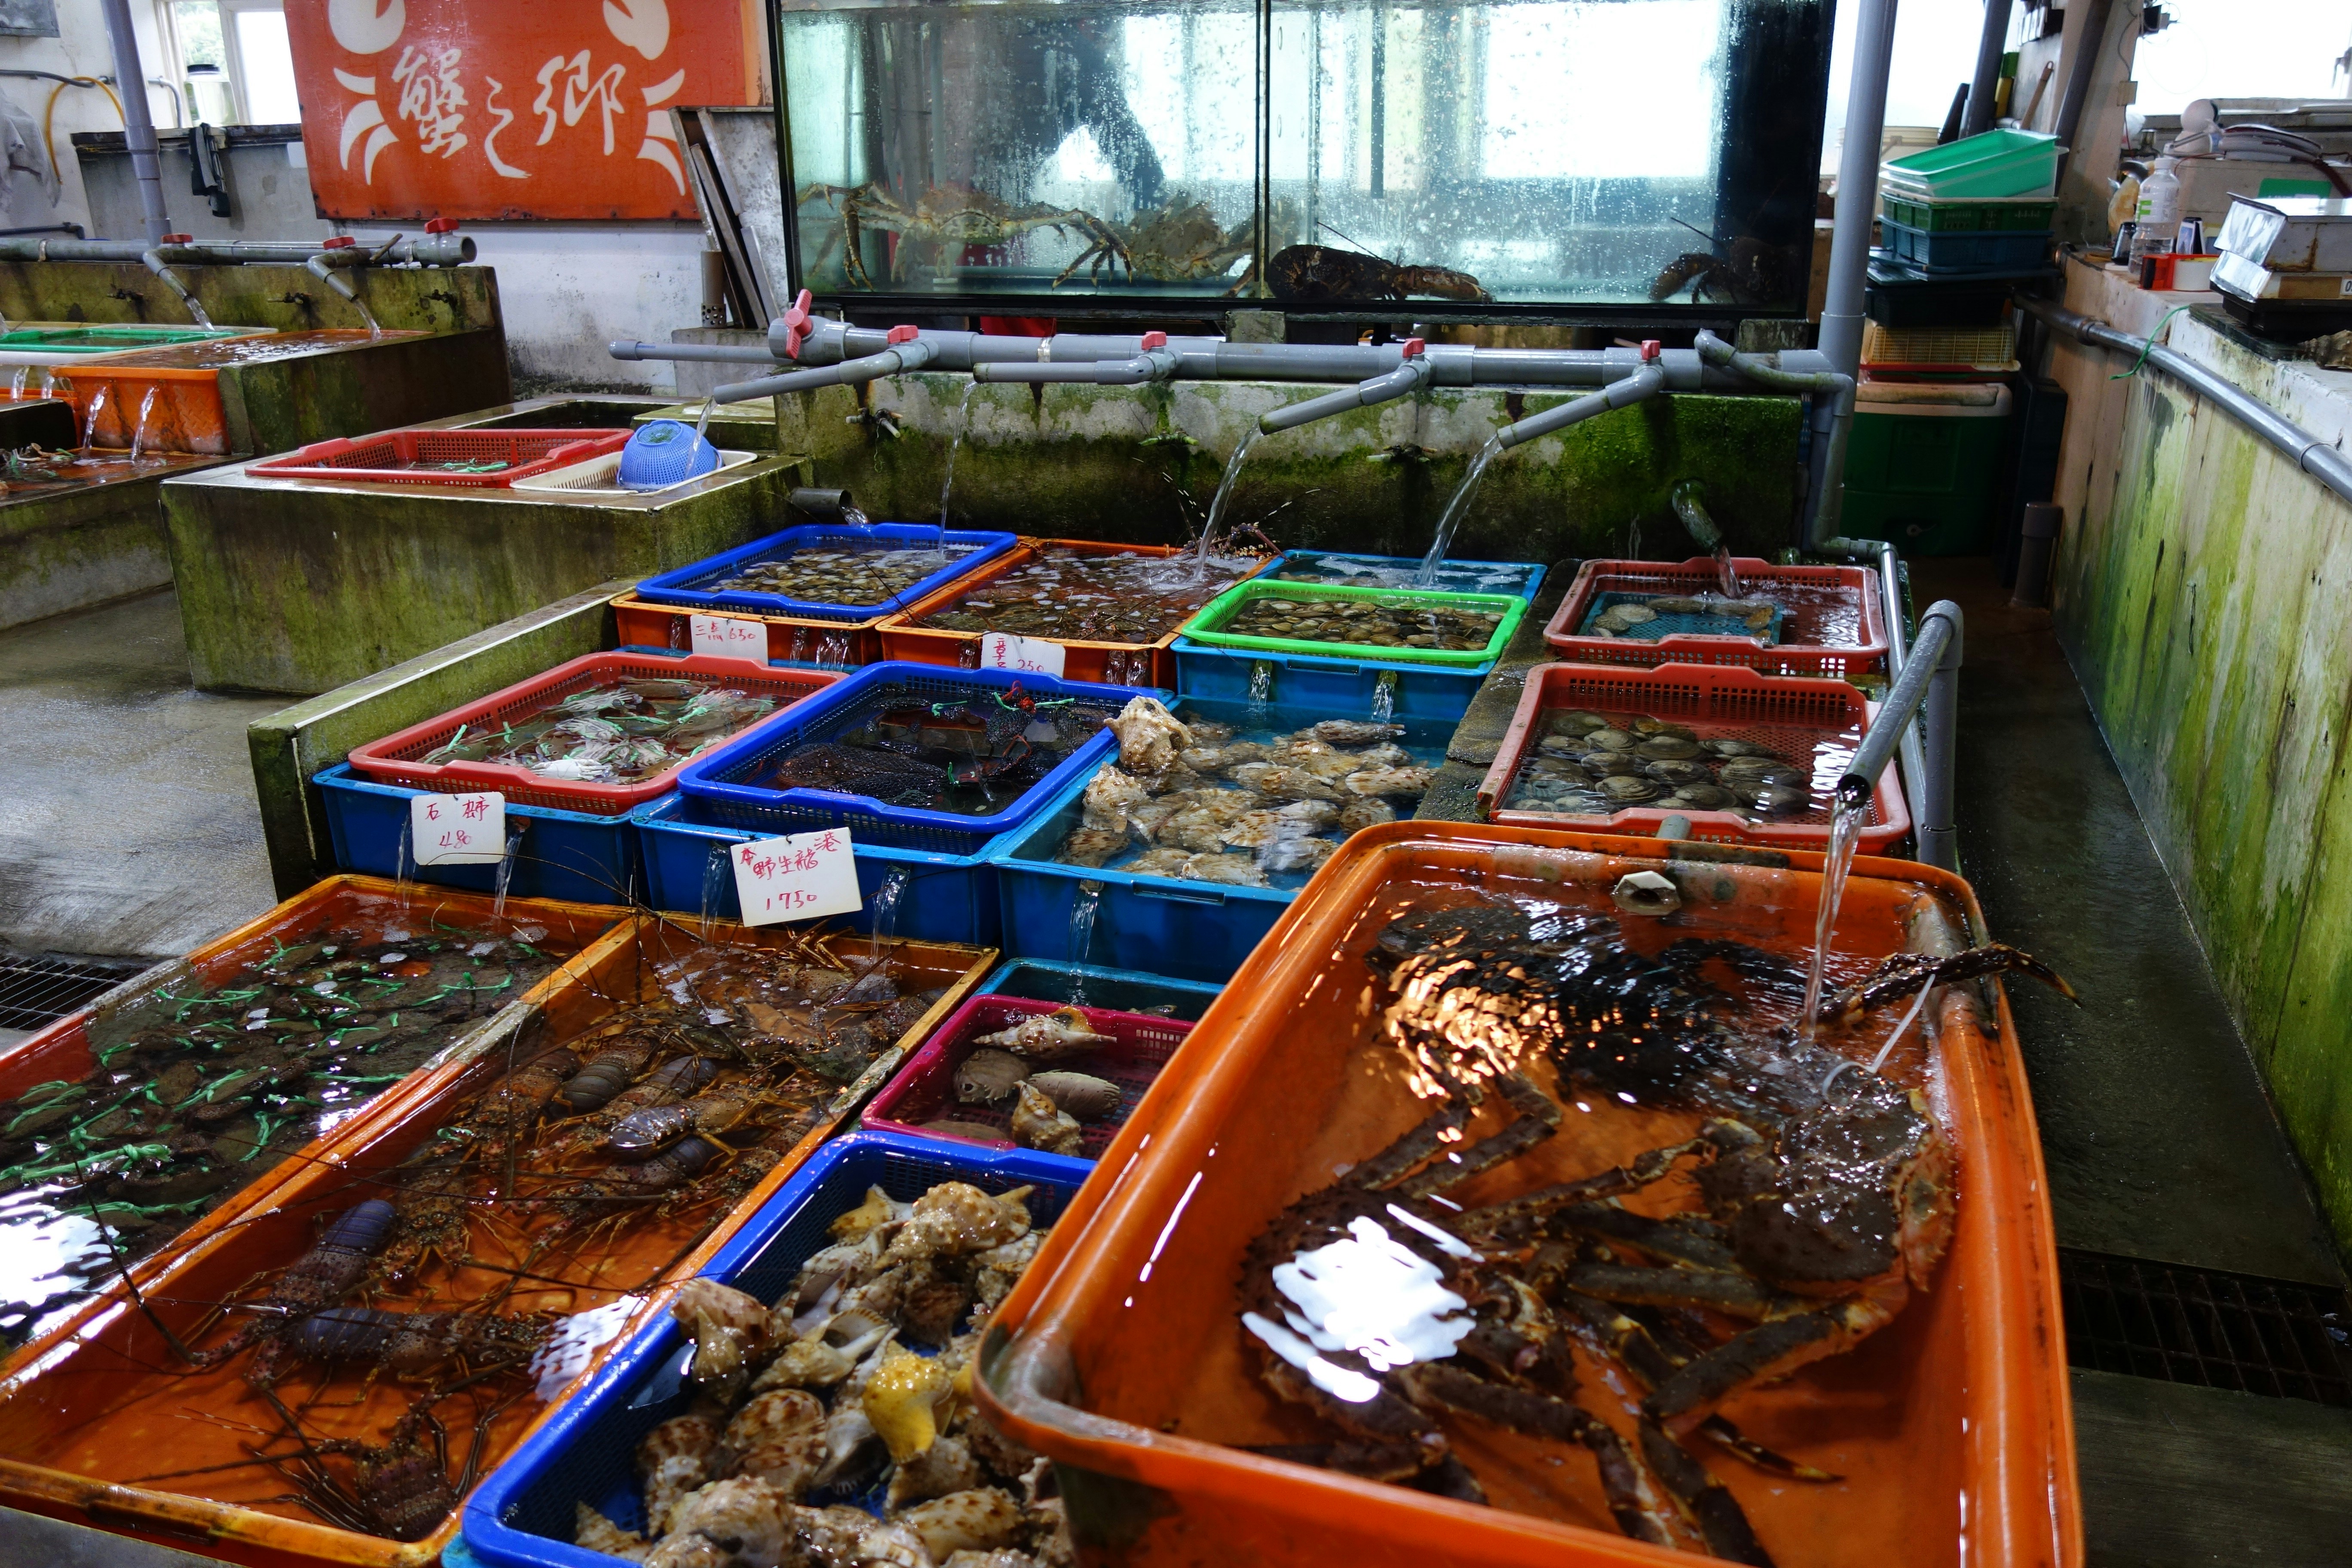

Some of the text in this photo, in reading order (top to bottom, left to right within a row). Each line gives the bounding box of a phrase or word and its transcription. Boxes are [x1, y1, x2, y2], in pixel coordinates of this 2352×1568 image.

[729, 628, 756, 641] 650
[1017, 659, 1044, 672] 250
[439, 830, 472, 849] 480
[766, 890, 817, 910] 1750
